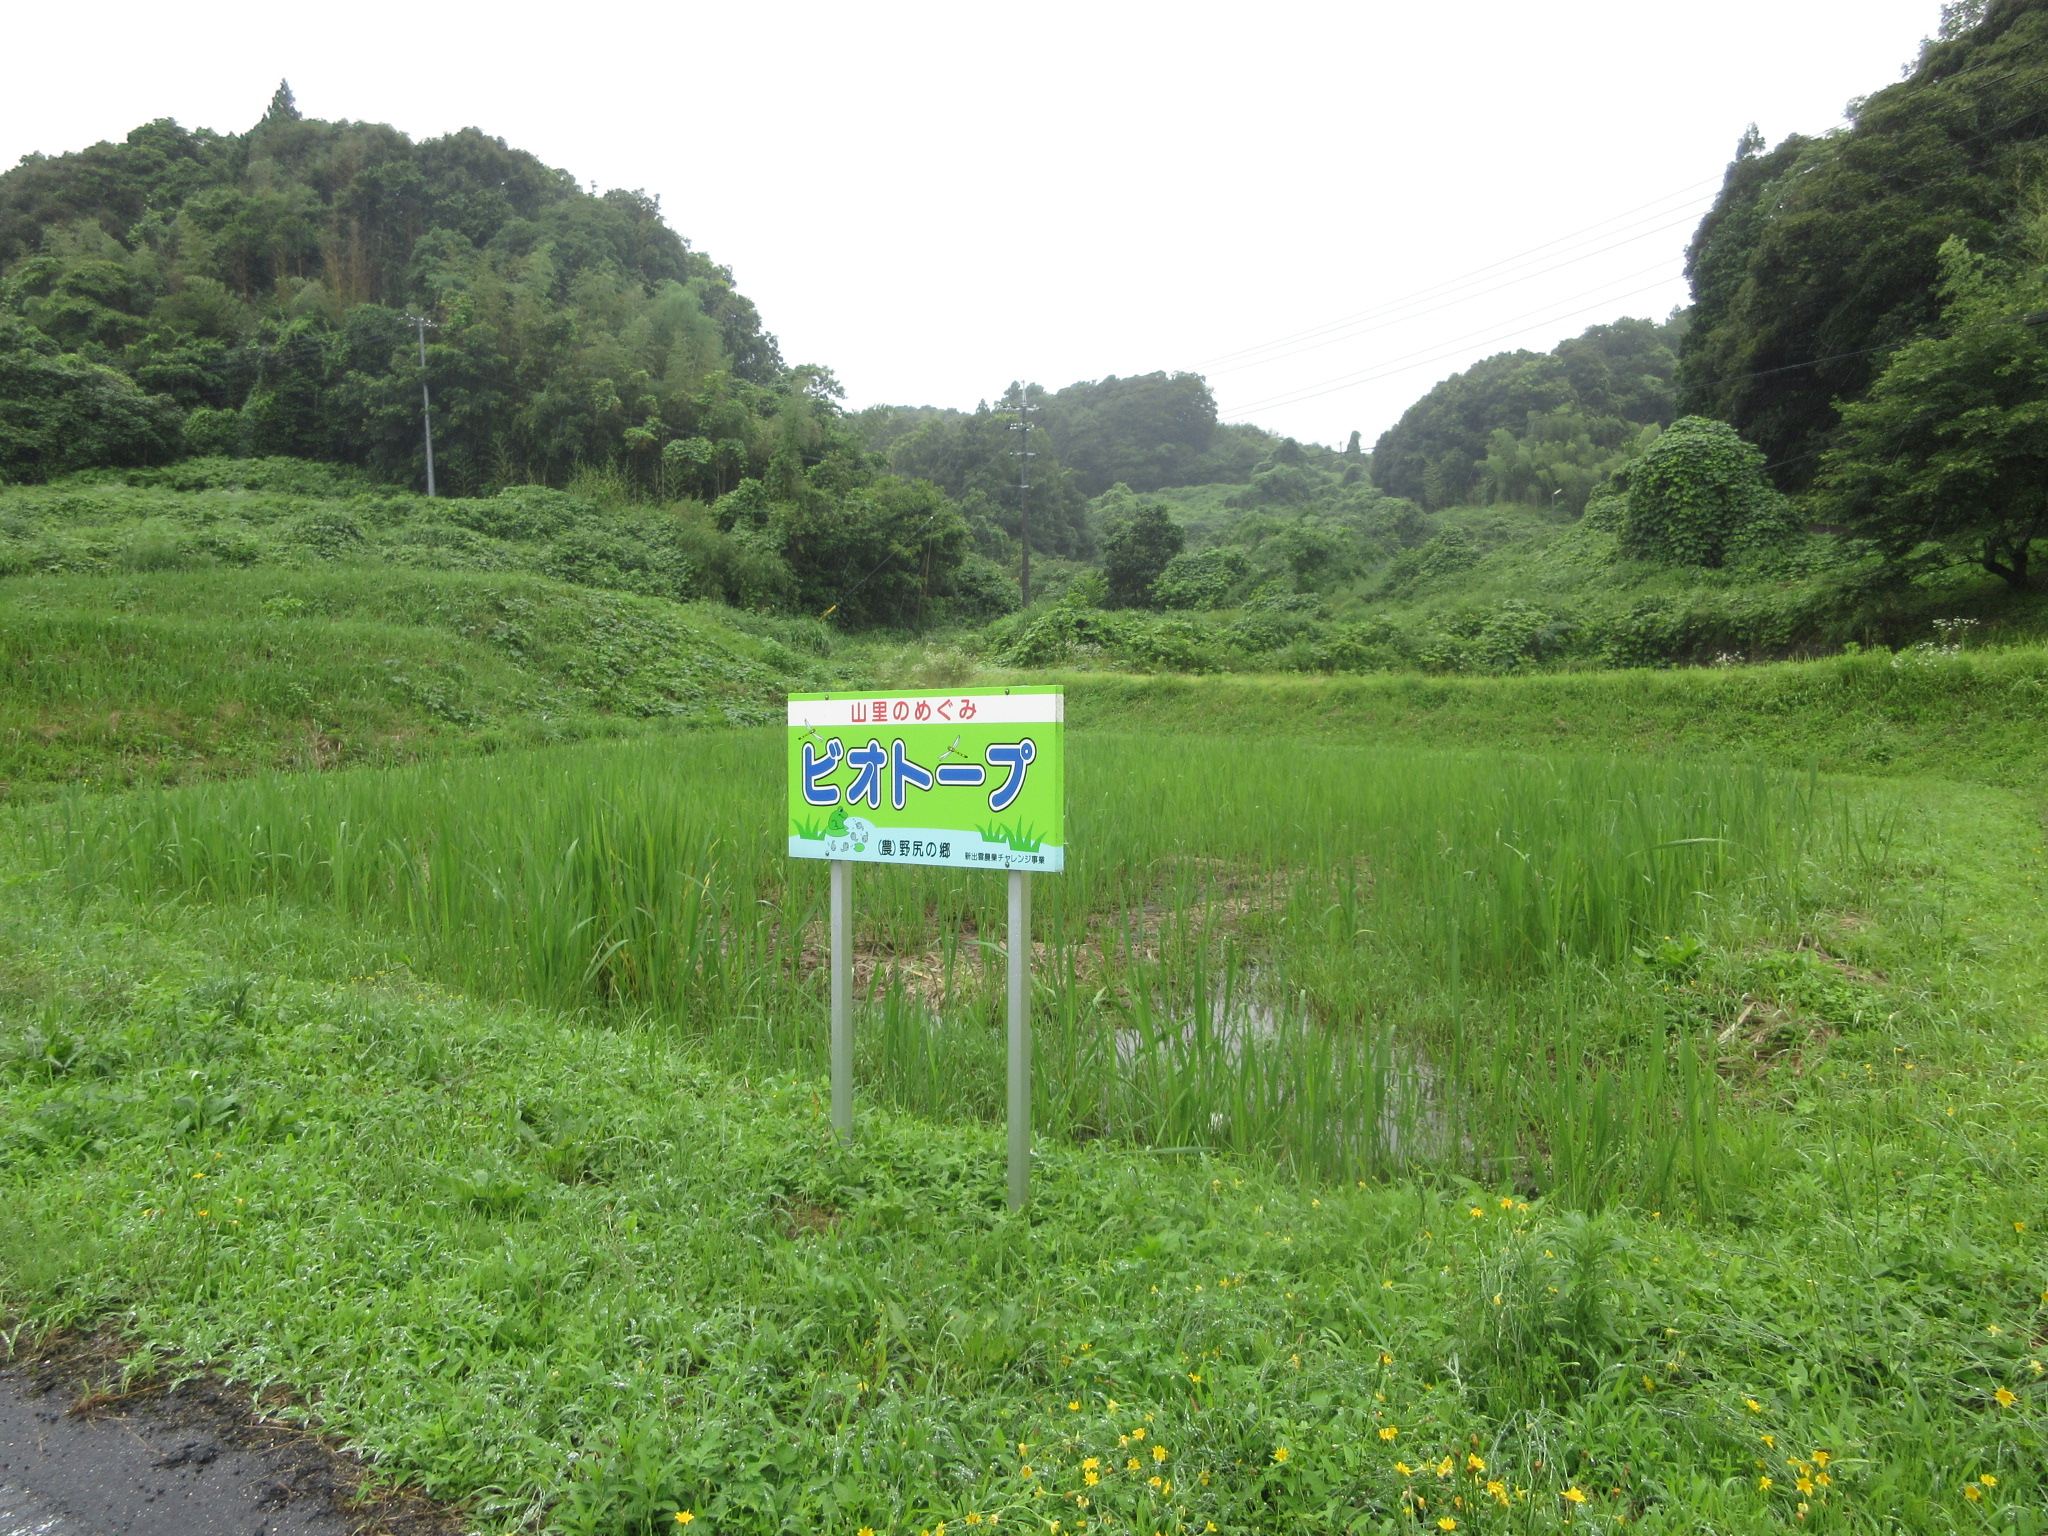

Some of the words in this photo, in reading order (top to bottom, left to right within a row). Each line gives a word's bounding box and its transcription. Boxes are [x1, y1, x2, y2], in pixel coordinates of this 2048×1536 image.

[851, 699, 977, 722] 山里のめぐみ
[802, 737, 1036, 812] ビオトープ
[964, 851, 1045, 865] 新出雲農業チャレンジ事業
